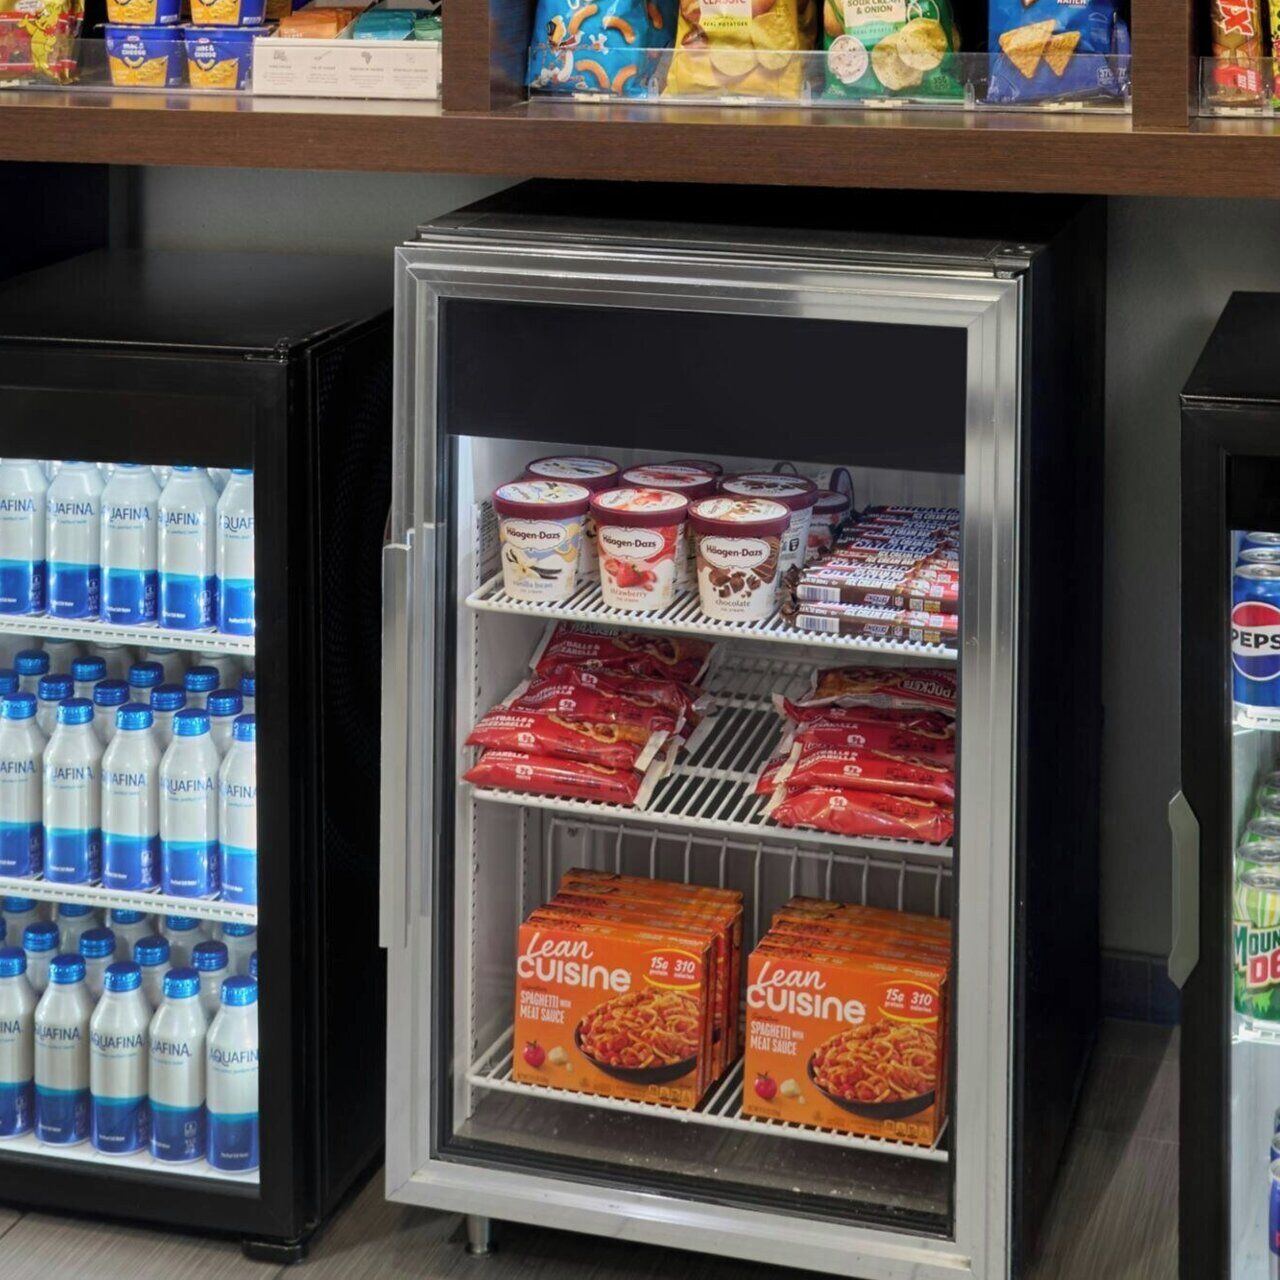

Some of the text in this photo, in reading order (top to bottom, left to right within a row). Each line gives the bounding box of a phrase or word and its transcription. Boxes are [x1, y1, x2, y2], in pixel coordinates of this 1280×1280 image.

[864, 4, 893, 14] ONION
[506, 527, 561, 540] Häagen-Dazs
[603, 535, 657, 549] Häagen-Dazs
[706, 546, 763, 558] Häagen-Dazs
[716, 598, 751, 608] chocolate
[527, 932, 593, 960] Lean
[674, 960, 695, 973] 310
[757, 961, 826, 988] Lean
[520, 990, 559, 1007] SPAGHETTI
[911, 992, 932, 1006] 310
[520, 1007, 565, 1024] MEAT SAUCE
[751, 1021, 790, 1039] SPAGHETTI
[751, 1038, 797, 1055] MEAT SAUCE
